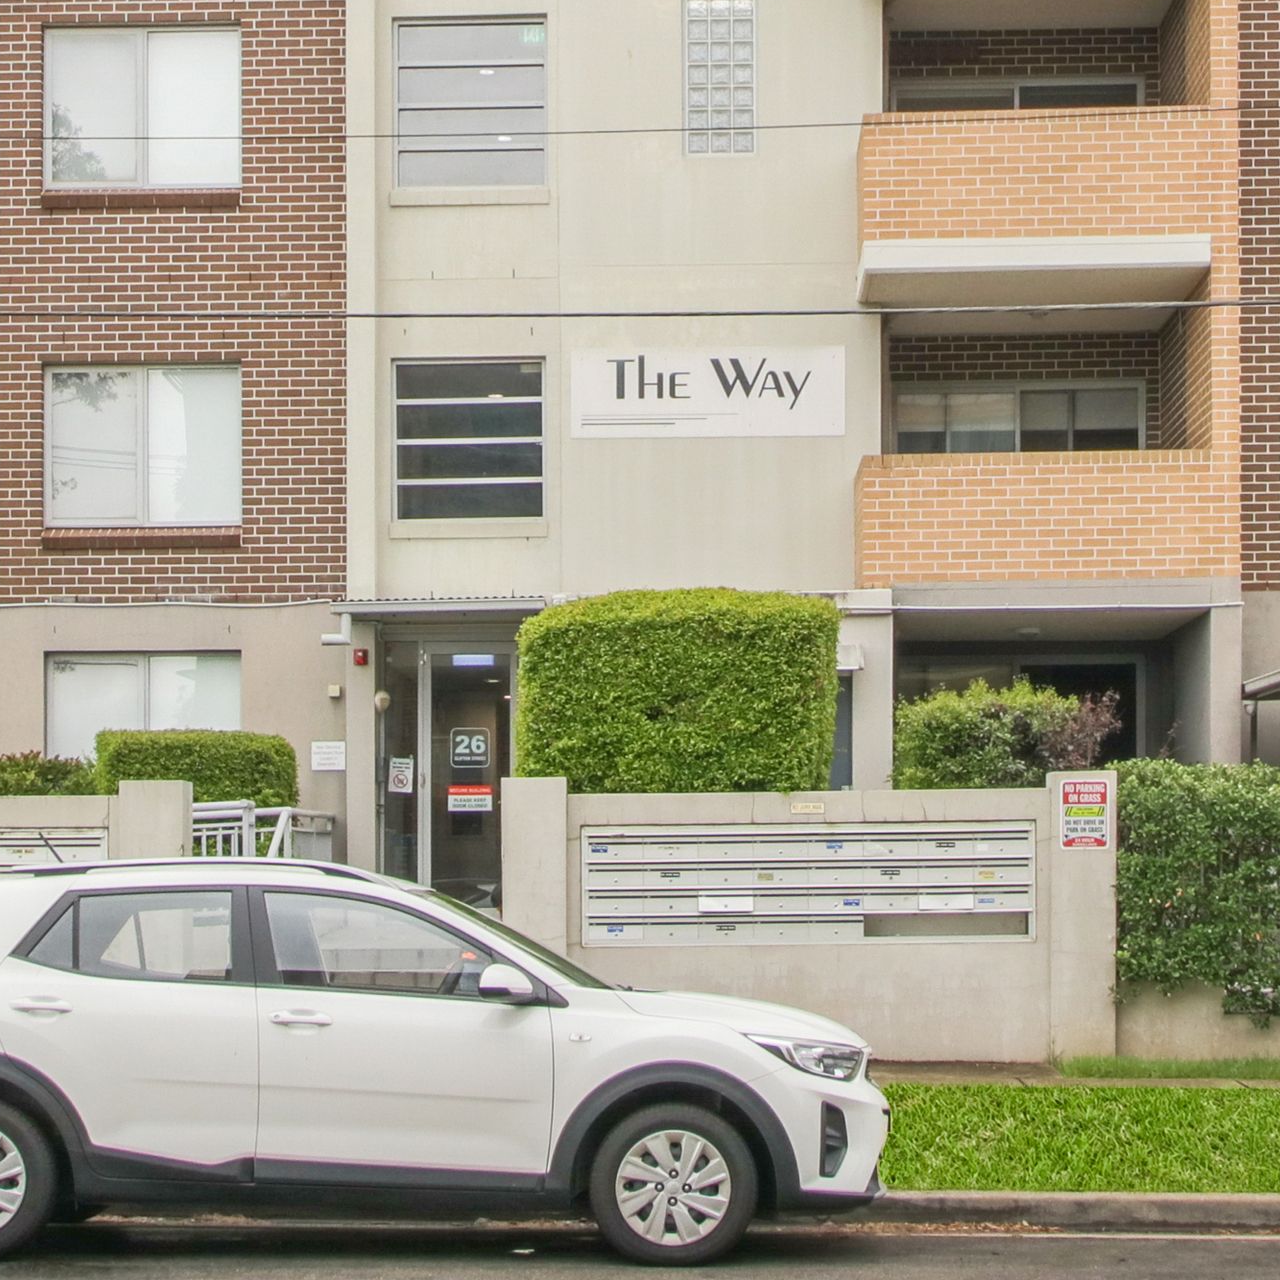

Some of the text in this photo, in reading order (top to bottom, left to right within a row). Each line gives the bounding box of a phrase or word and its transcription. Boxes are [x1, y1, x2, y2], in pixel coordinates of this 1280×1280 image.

[607, 355, 812, 410] The Way
[454, 735, 486, 754] 26
[1064, 783, 1105, 793] NO PARKING
[1068, 793, 1101, 803] ON GRASS
